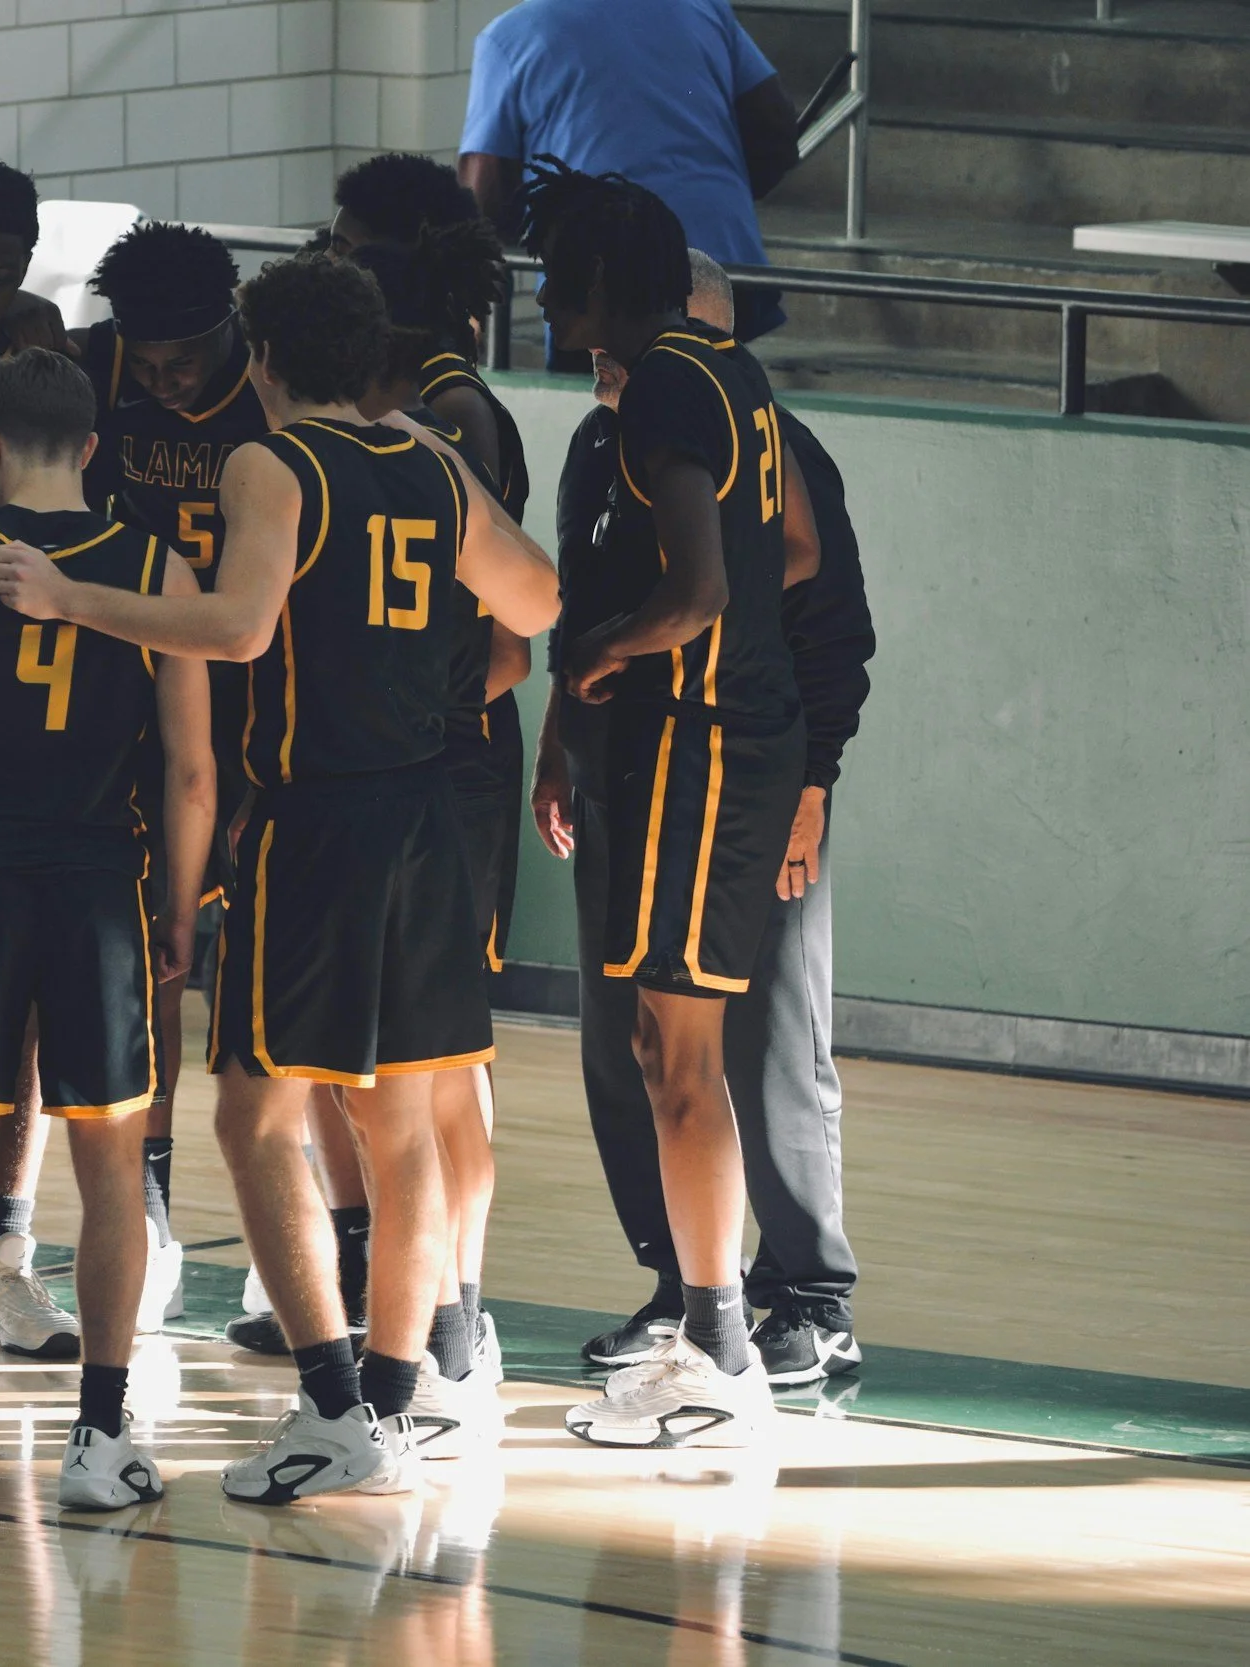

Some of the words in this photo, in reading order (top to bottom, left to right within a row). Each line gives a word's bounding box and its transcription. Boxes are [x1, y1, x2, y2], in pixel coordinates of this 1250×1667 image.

[753, 401, 782, 524] 21
[178, 502, 215, 569] 5
[367, 514, 436, 631] 15
[16, 624, 78, 731] 4
